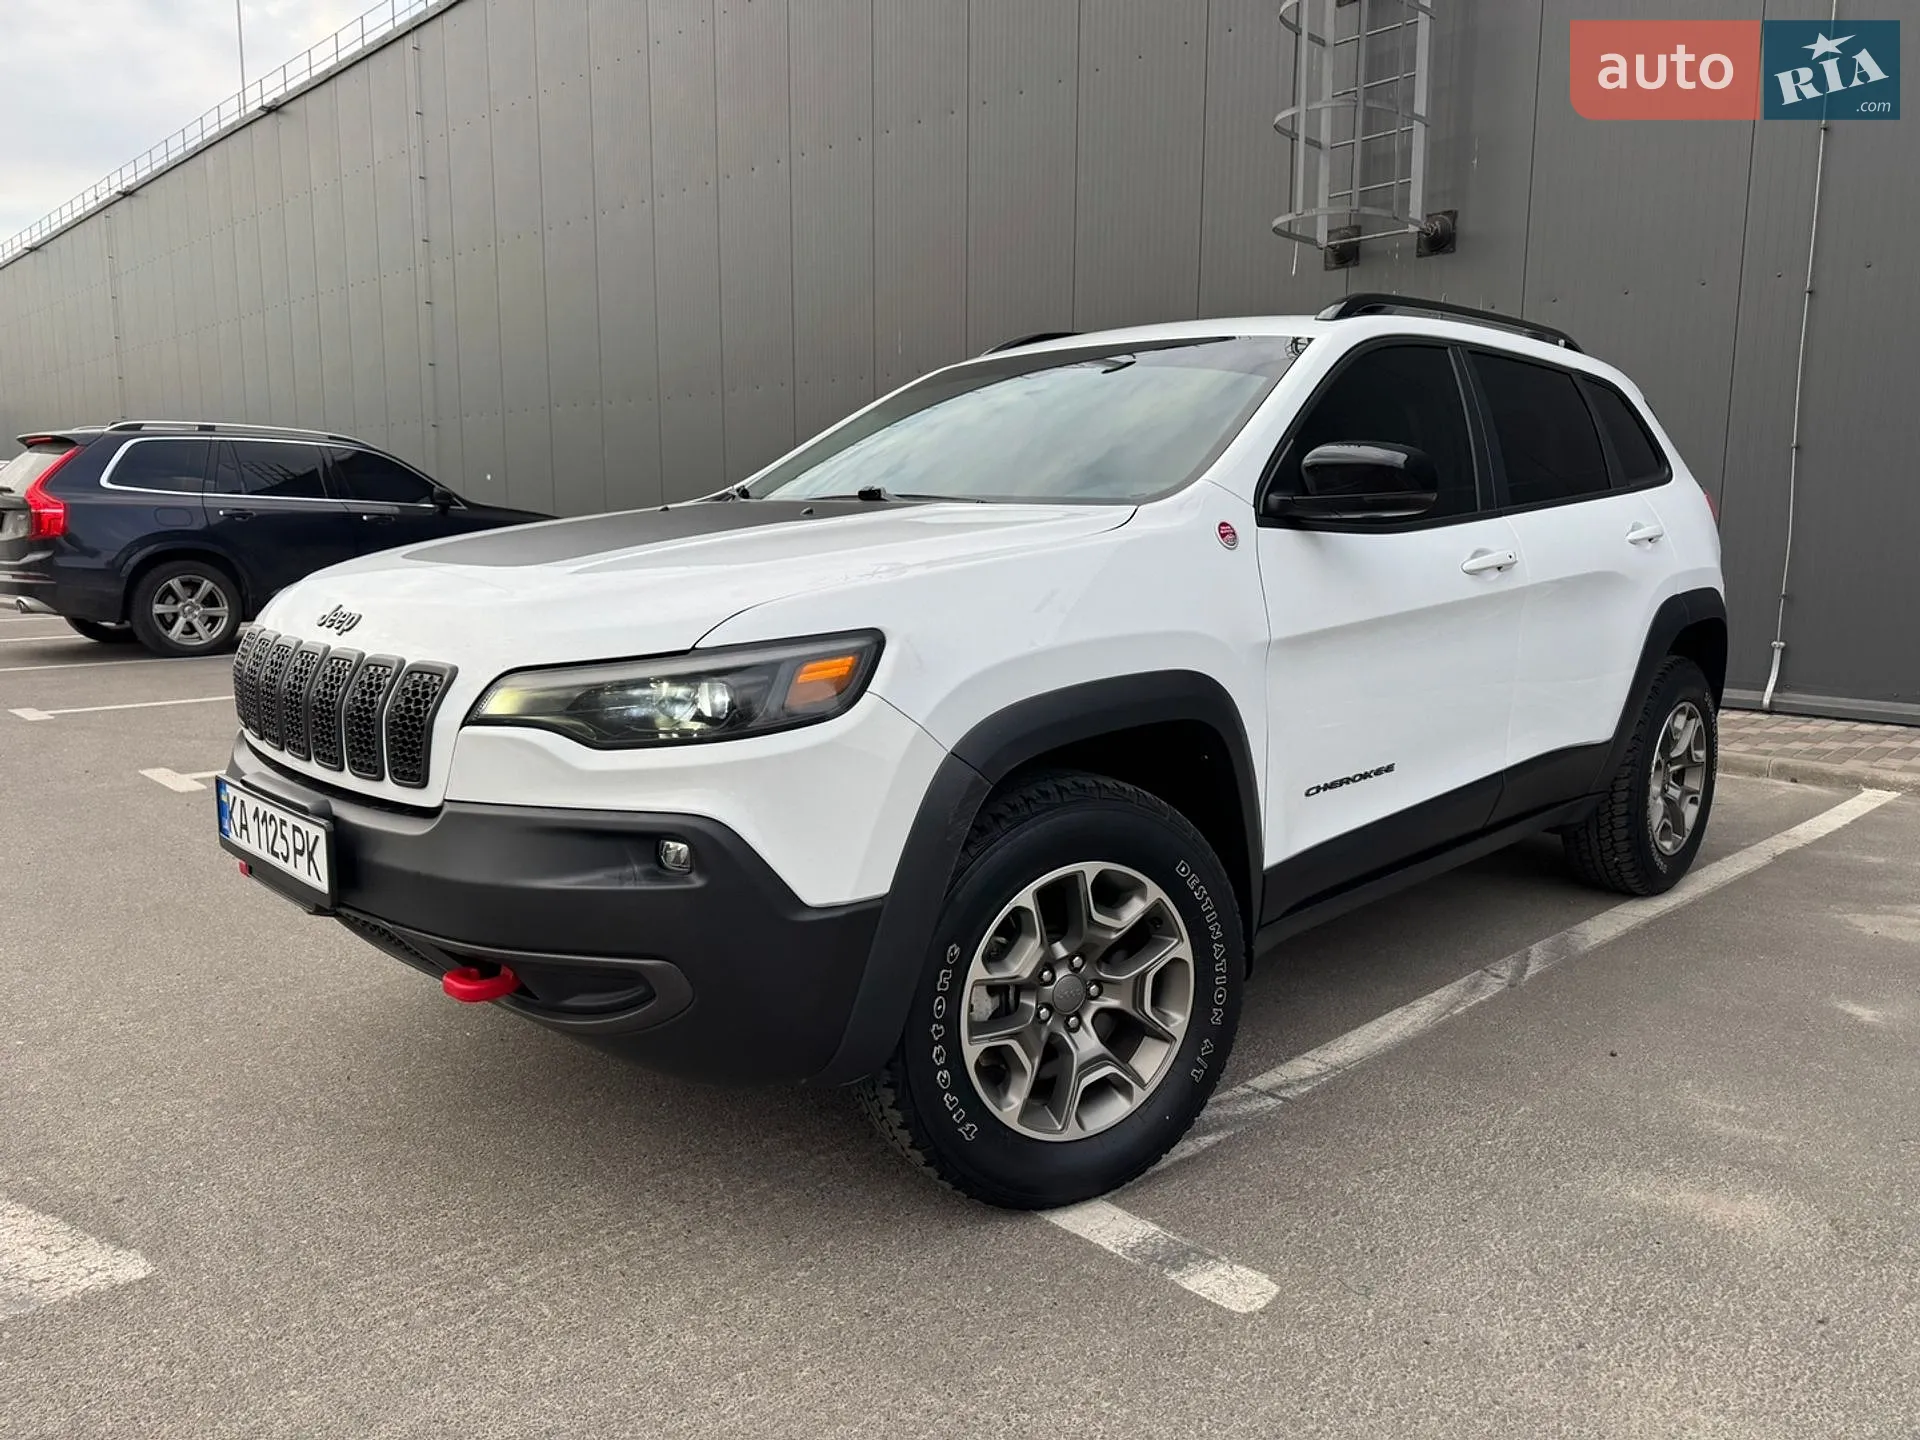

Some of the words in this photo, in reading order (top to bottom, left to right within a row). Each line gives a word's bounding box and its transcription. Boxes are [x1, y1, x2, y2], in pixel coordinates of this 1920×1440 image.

[317, 604, 362, 636] Jeep
[1304, 763, 1396, 797] CHEROKEE
[1175, 860, 1228, 1026] DESTINATION
[930, 943, 979, 1141] Firestone
[1190, 1038, 1215, 1084] A/T
